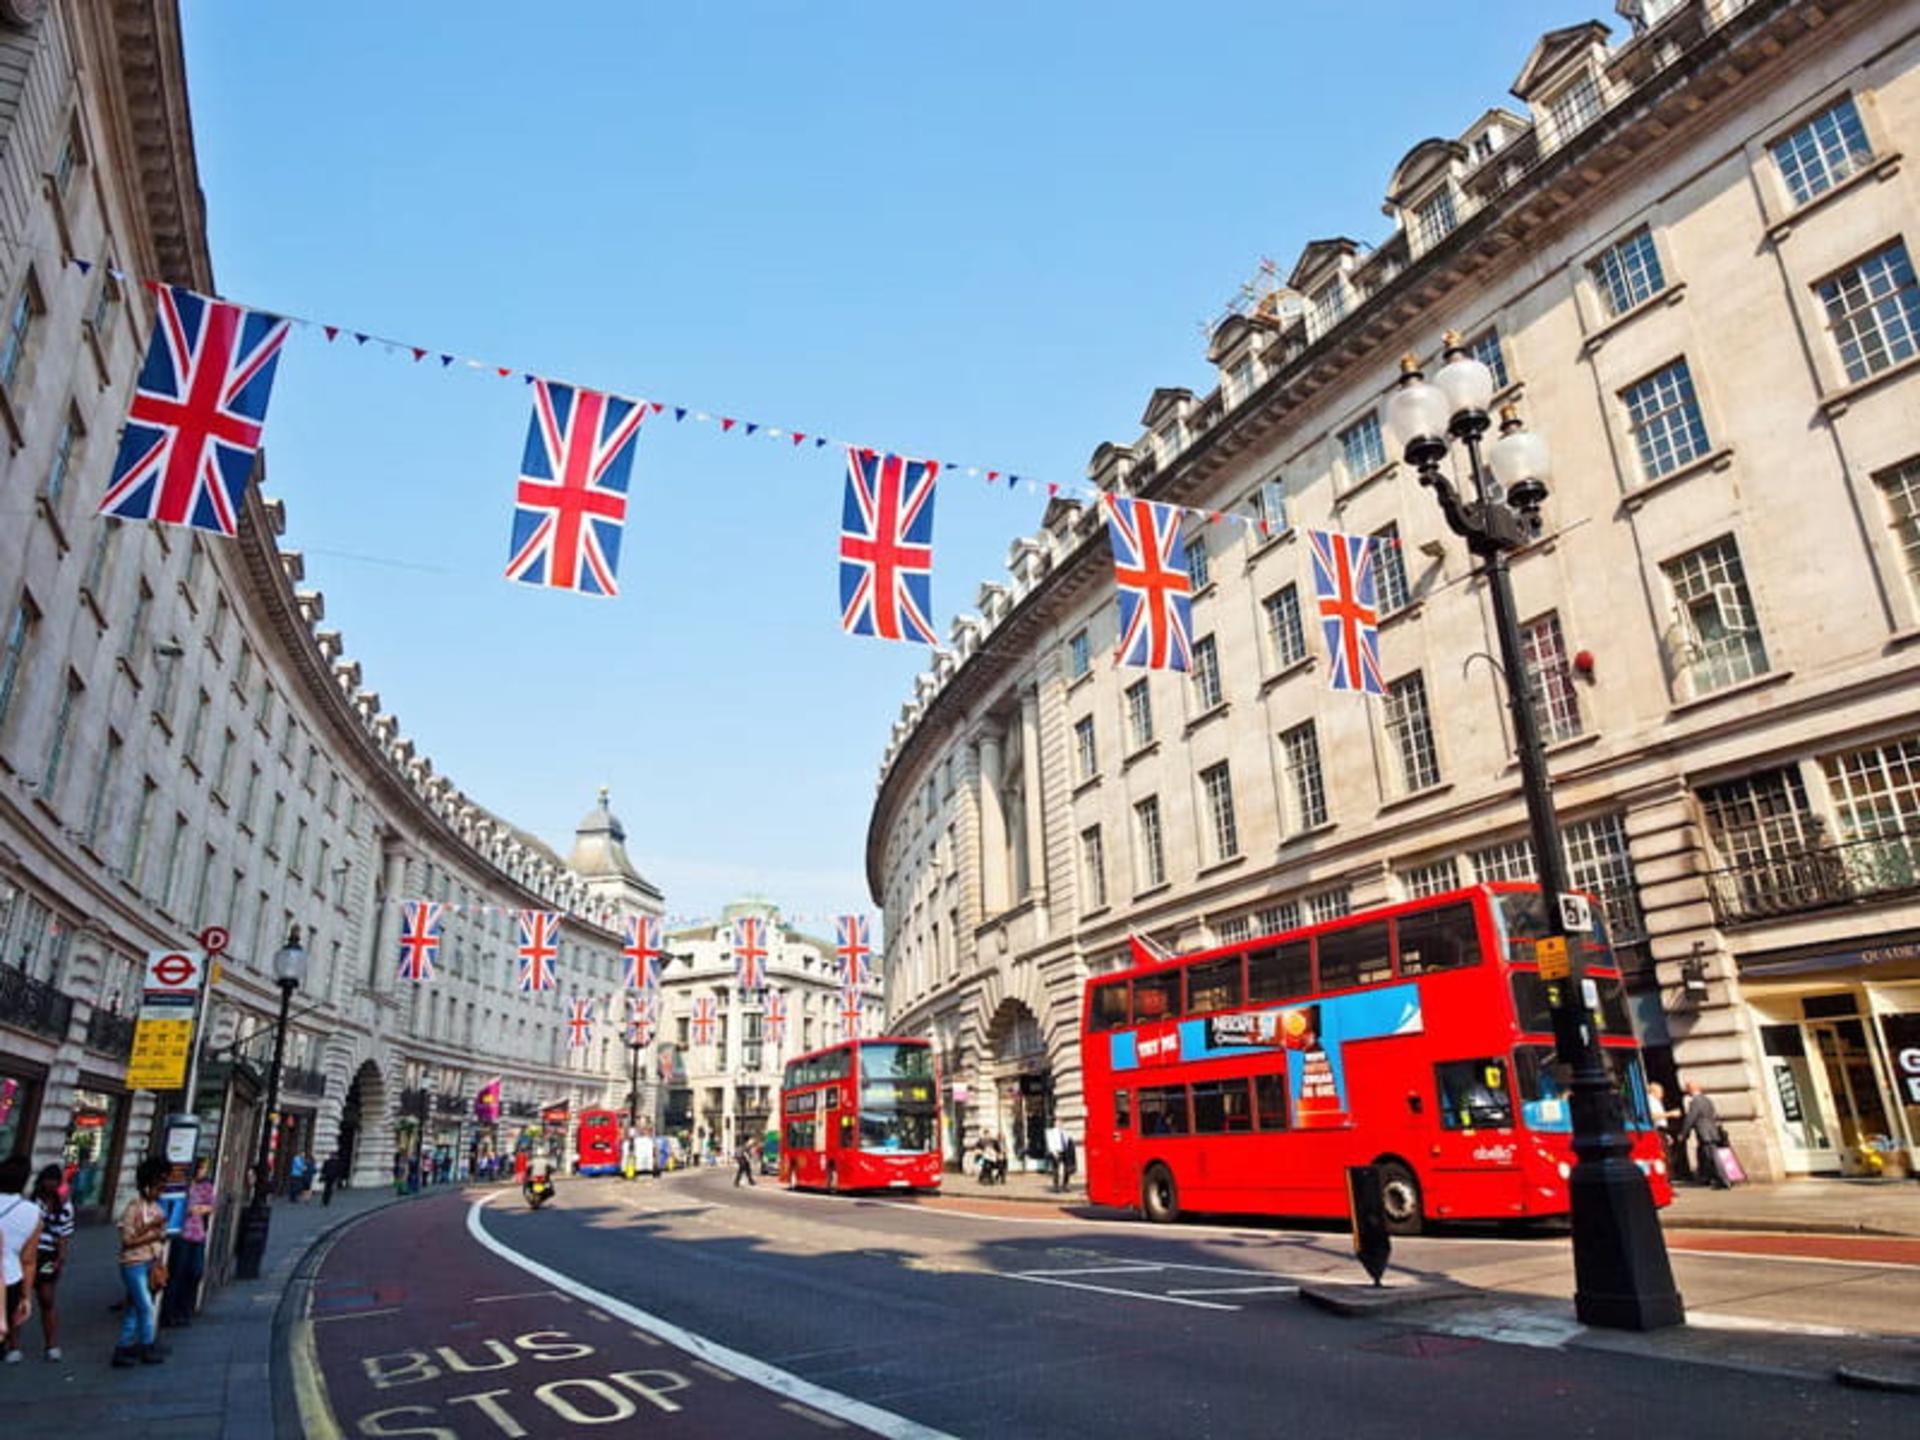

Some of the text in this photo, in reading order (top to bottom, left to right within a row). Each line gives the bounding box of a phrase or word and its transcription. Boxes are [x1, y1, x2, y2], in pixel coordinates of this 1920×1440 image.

[207, 930, 226, 949] D
[361, 1331, 595, 1389] BUS
[357, 1369, 692, 1440] STOP
